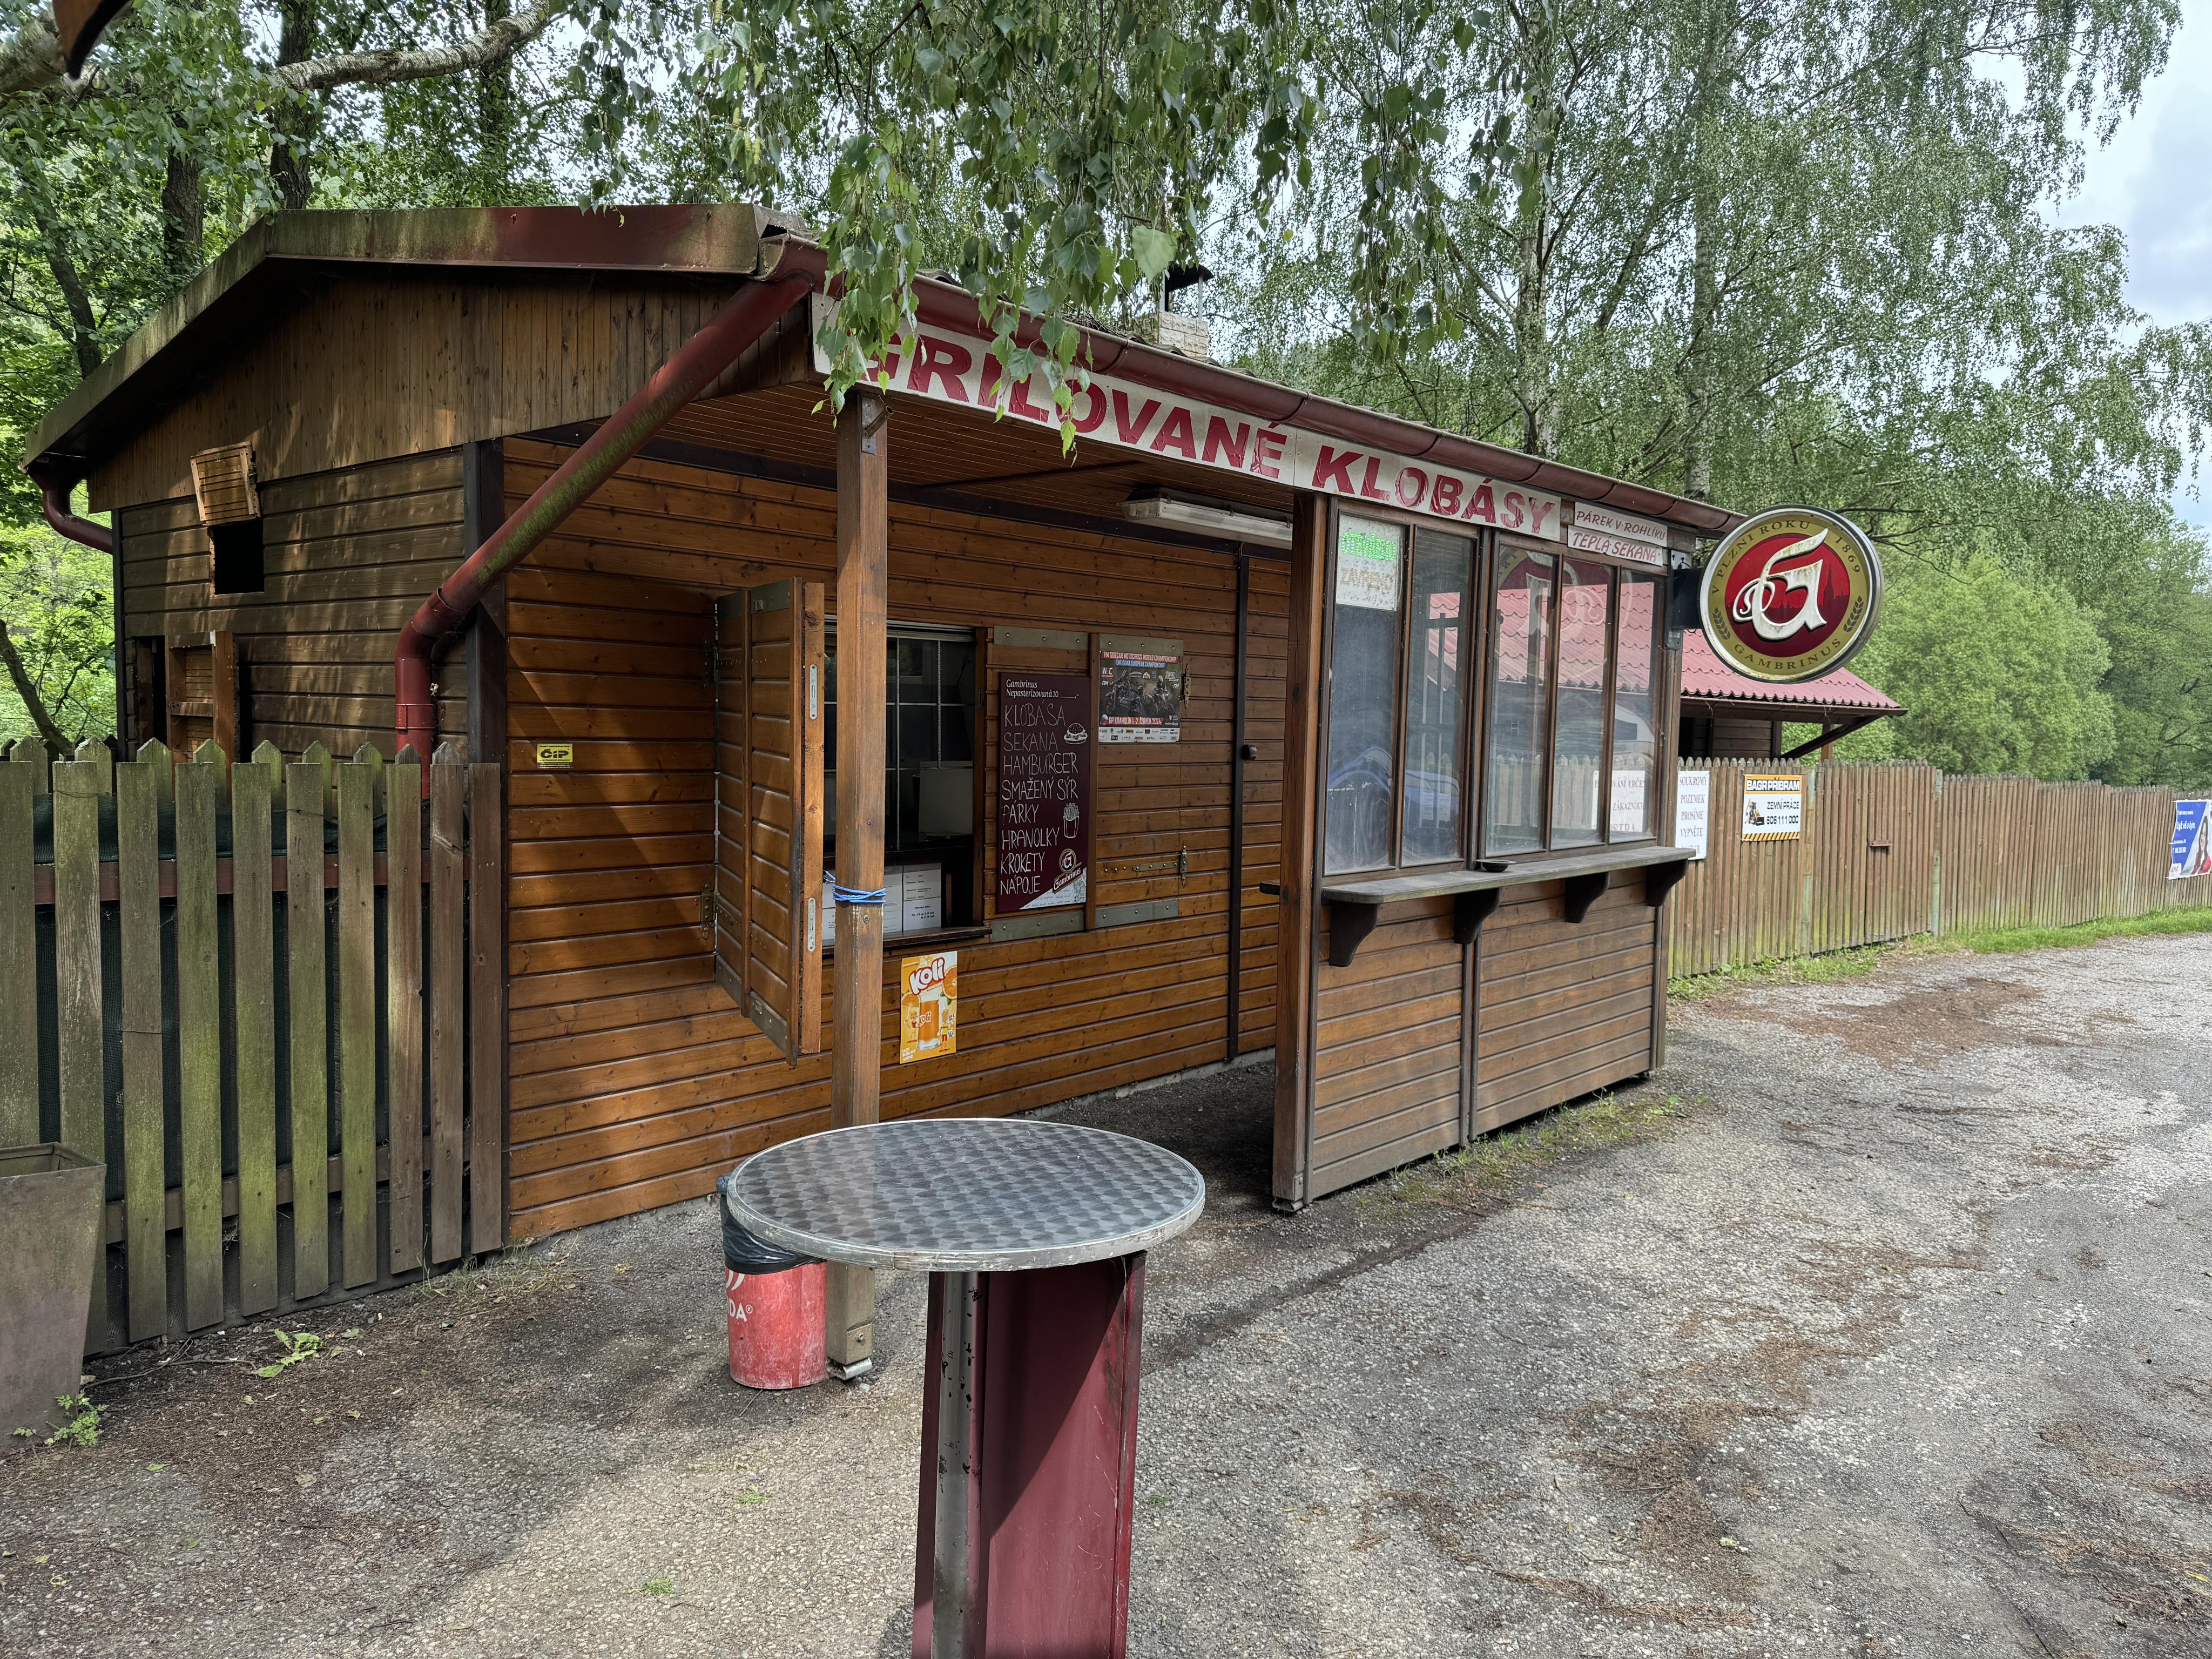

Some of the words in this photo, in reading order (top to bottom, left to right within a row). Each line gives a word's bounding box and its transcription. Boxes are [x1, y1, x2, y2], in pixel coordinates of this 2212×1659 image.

[1312, 445, 1555, 534] KLOBÁSY
[1576, 511, 1613, 528] PÁREK
[1624, 522, 1665, 540] ROHLÍKU
[1573, 532, 1609, 552] TEPLÁ
[1711, 585, 1720, 594] V
[1716, 534, 1755, 579] PLZNI
[1758, 520, 1811, 535] ROKU
[1835, 536, 1860, 573] 1869
[1734, 638, 1841, 670] GAMBRINUS
[1006, 679, 1037, 689] Gambrinus
[1006, 689, 1053, 699] Nepasterizovaná
[1004, 699, 1066, 727] KLOBÁSA
[1003, 752, 1078, 775] HAMBURGER
[1002, 776, 1054, 800] SMAŽENÝ
[1057, 776, 1078, 800] SÝR
[1746, 779, 1768, 791] BAGR
[1681, 794, 1705, 804] POZEMEK
[1002, 800, 1039, 826] PÁRKY
[1681, 808, 1703, 820] PROSÍME
[1002, 827, 1060, 850] HRANOLKY
[1001, 852, 1046, 875] KROKETY
[1000, 874, 1041, 895] NÁPOJE
[1054, 868, 1081, 890] Gambrinus
